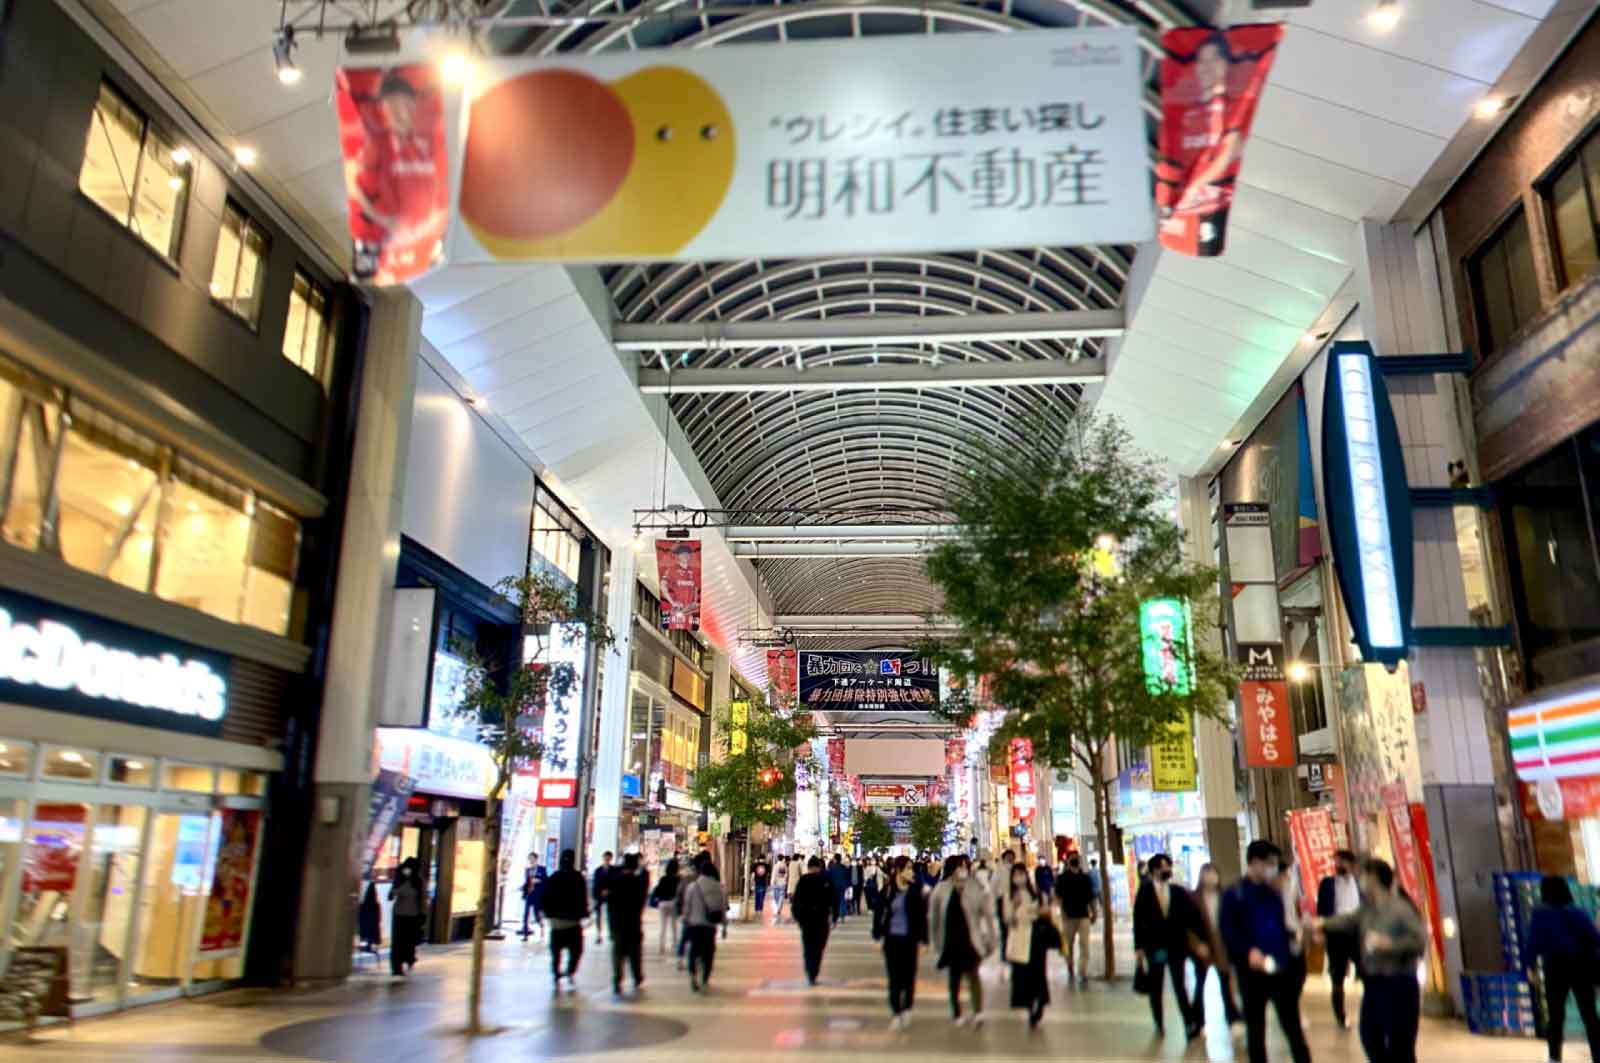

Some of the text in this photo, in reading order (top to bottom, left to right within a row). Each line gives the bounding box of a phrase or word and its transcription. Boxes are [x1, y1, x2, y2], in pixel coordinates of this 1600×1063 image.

[766, 145, 1109, 220] 明和不動産
[1256, 687, 1279, 761] みやはら
